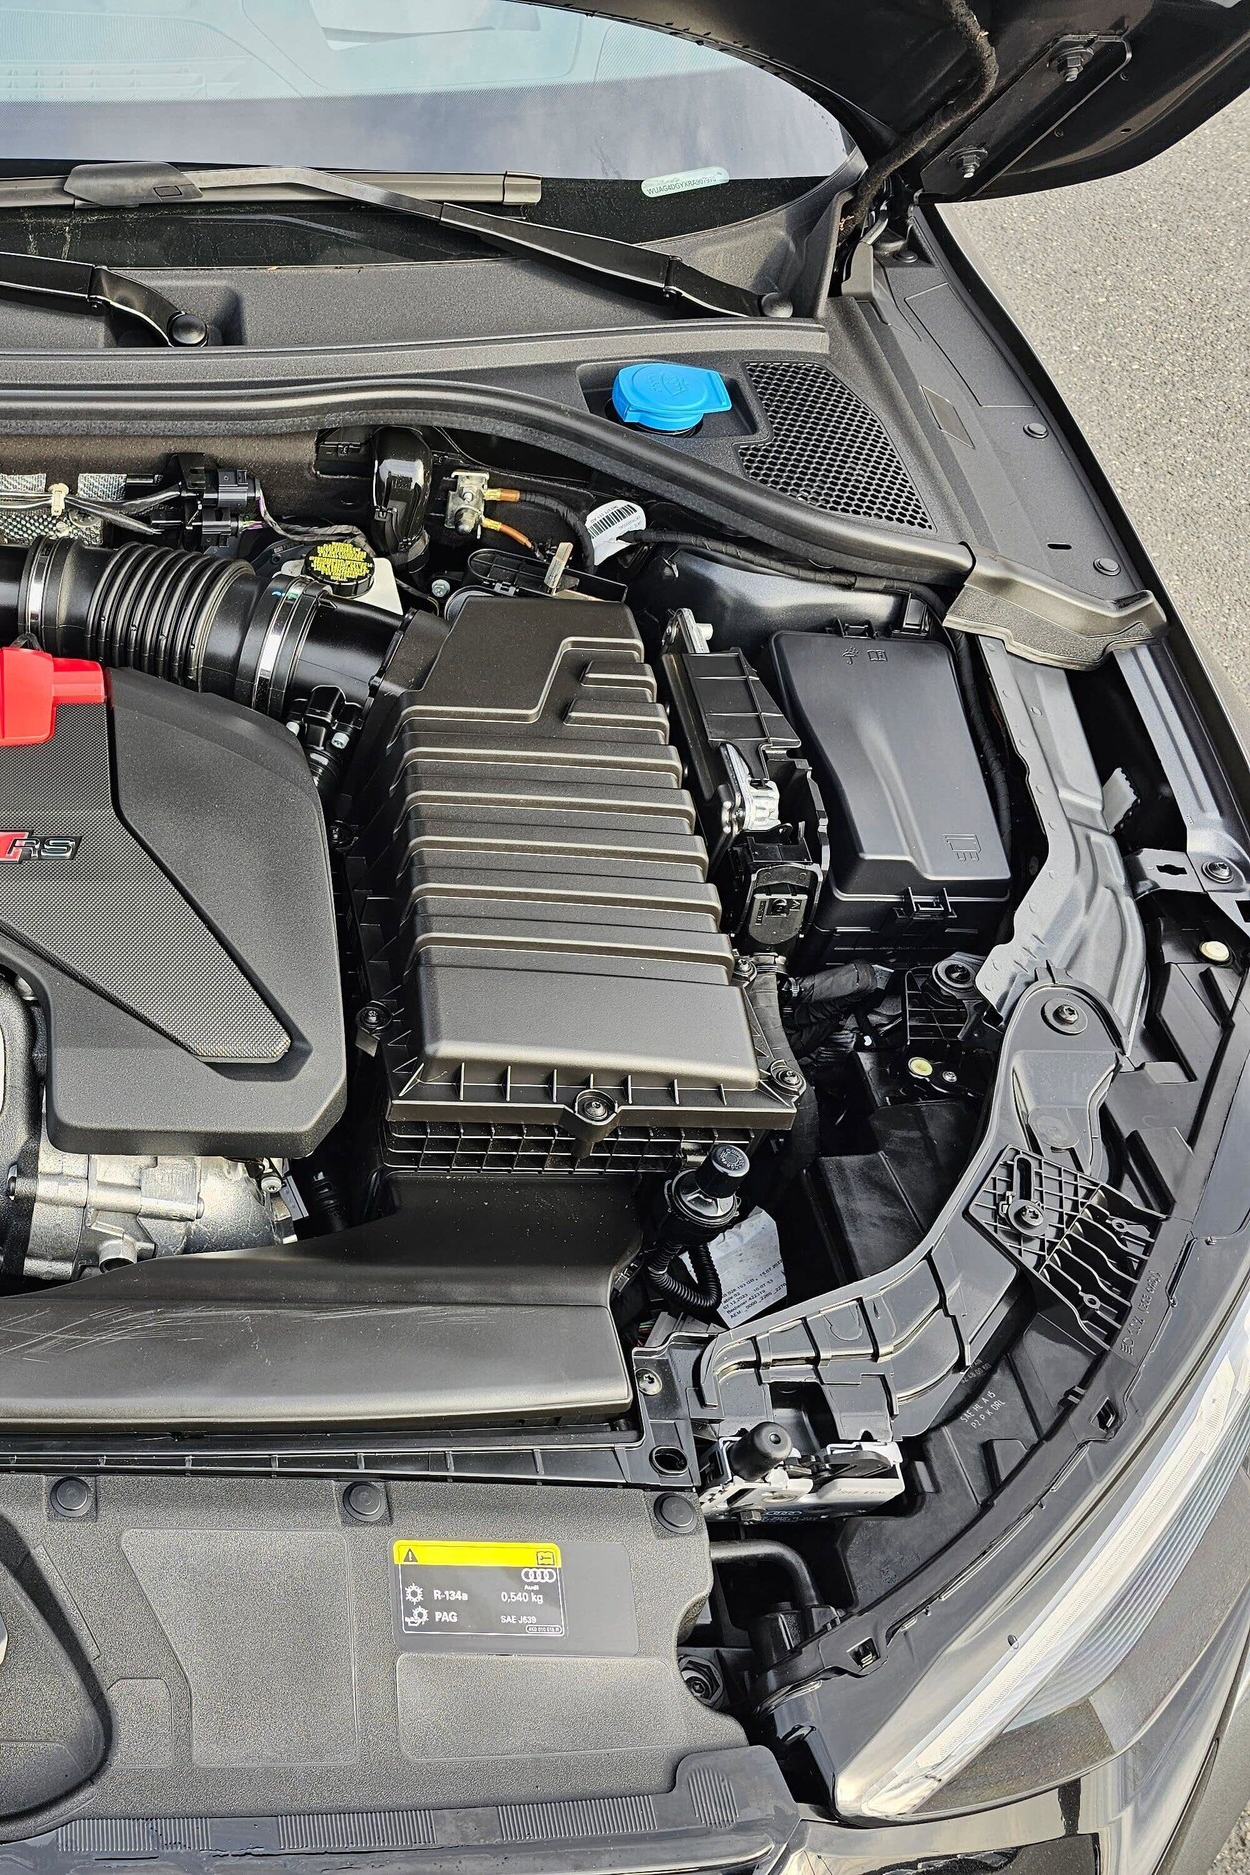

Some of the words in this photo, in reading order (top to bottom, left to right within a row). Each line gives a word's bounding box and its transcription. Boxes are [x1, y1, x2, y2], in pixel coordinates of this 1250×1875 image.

[960, 1410, 975, 1422] SAE
[433, 1590, 468, 1600] R-134a
[501, 1592, 528, 1602] 0,540
[531, 1593, 543, 1604] kg
[435, 1612, 457, 1622] PAG
